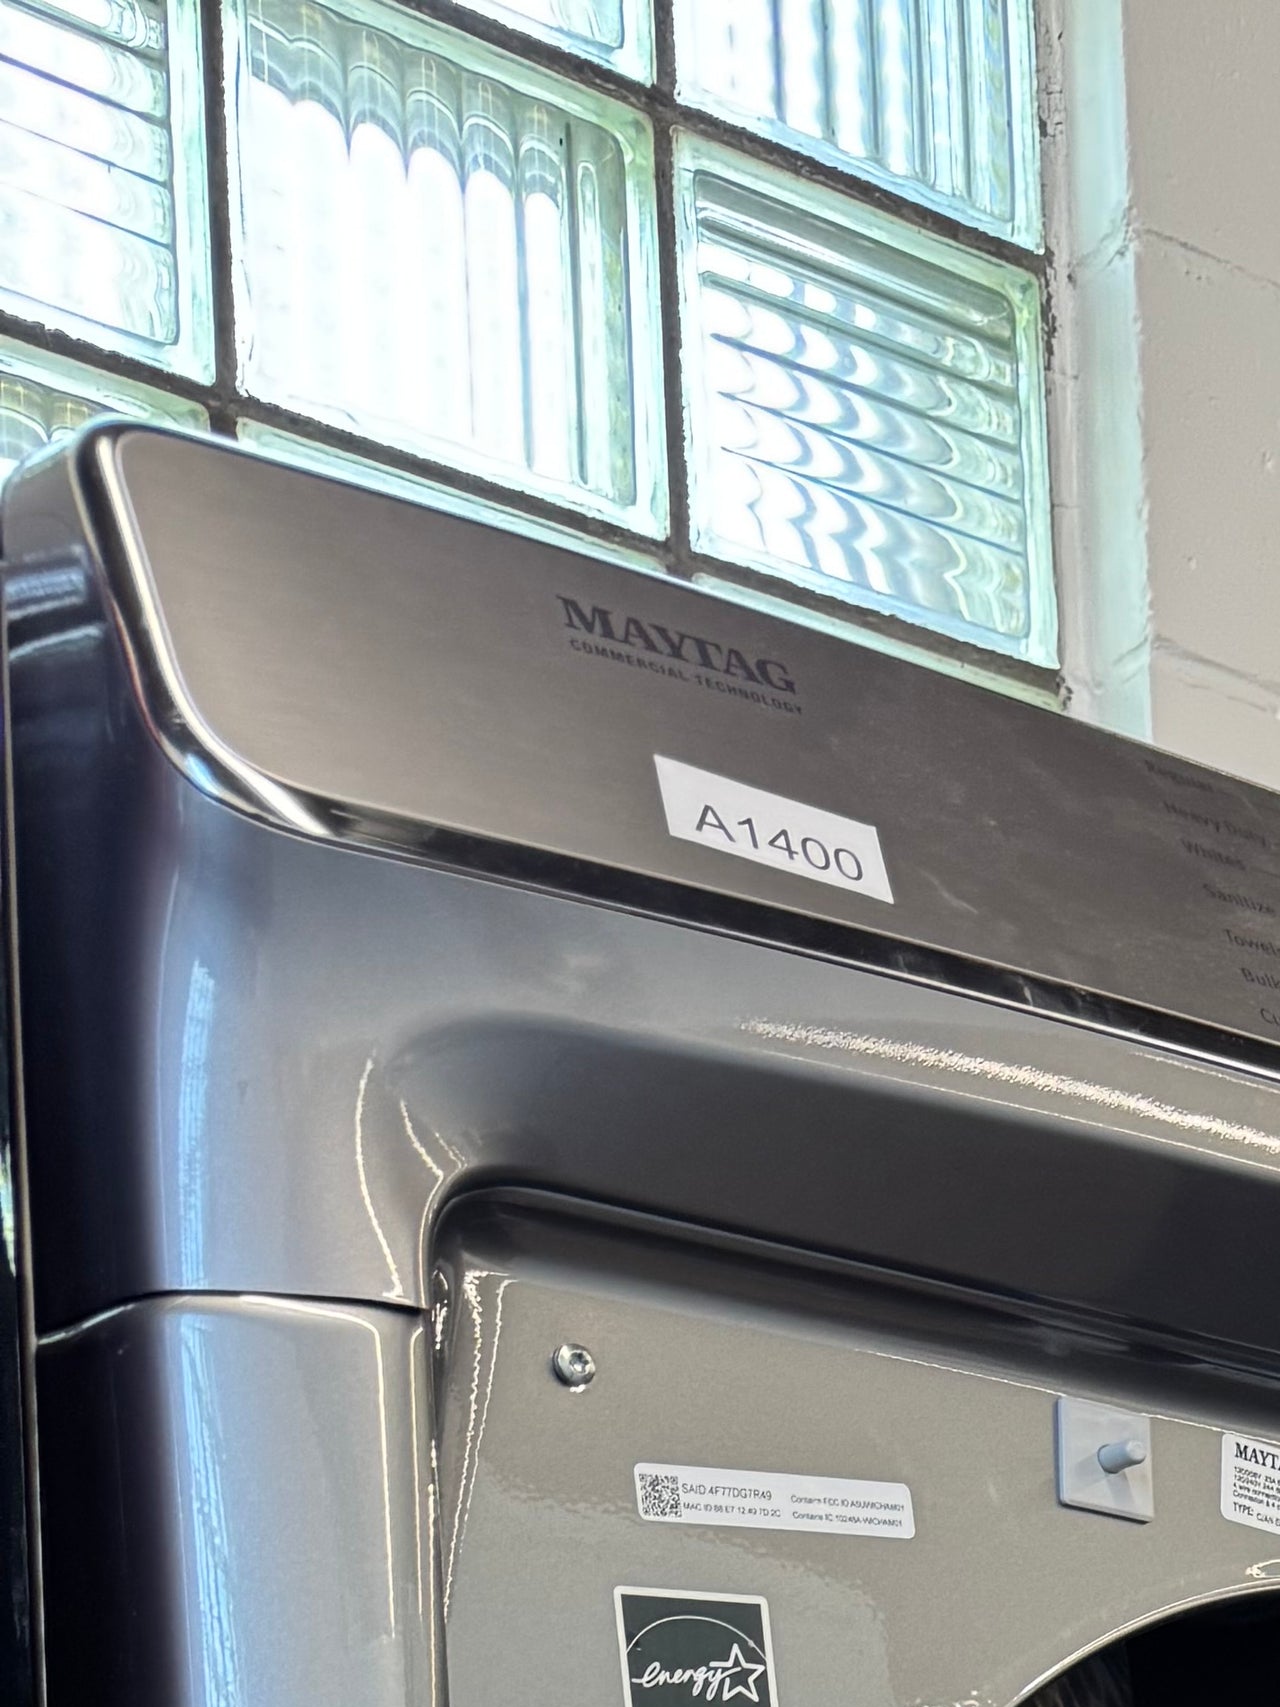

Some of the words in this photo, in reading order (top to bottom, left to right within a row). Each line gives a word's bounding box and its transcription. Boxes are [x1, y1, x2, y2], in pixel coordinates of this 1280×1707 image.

[557, 594, 797, 694] MAYTAG
[695, 804, 864, 882] A1400
[682, 1483, 706, 1495] SAID
